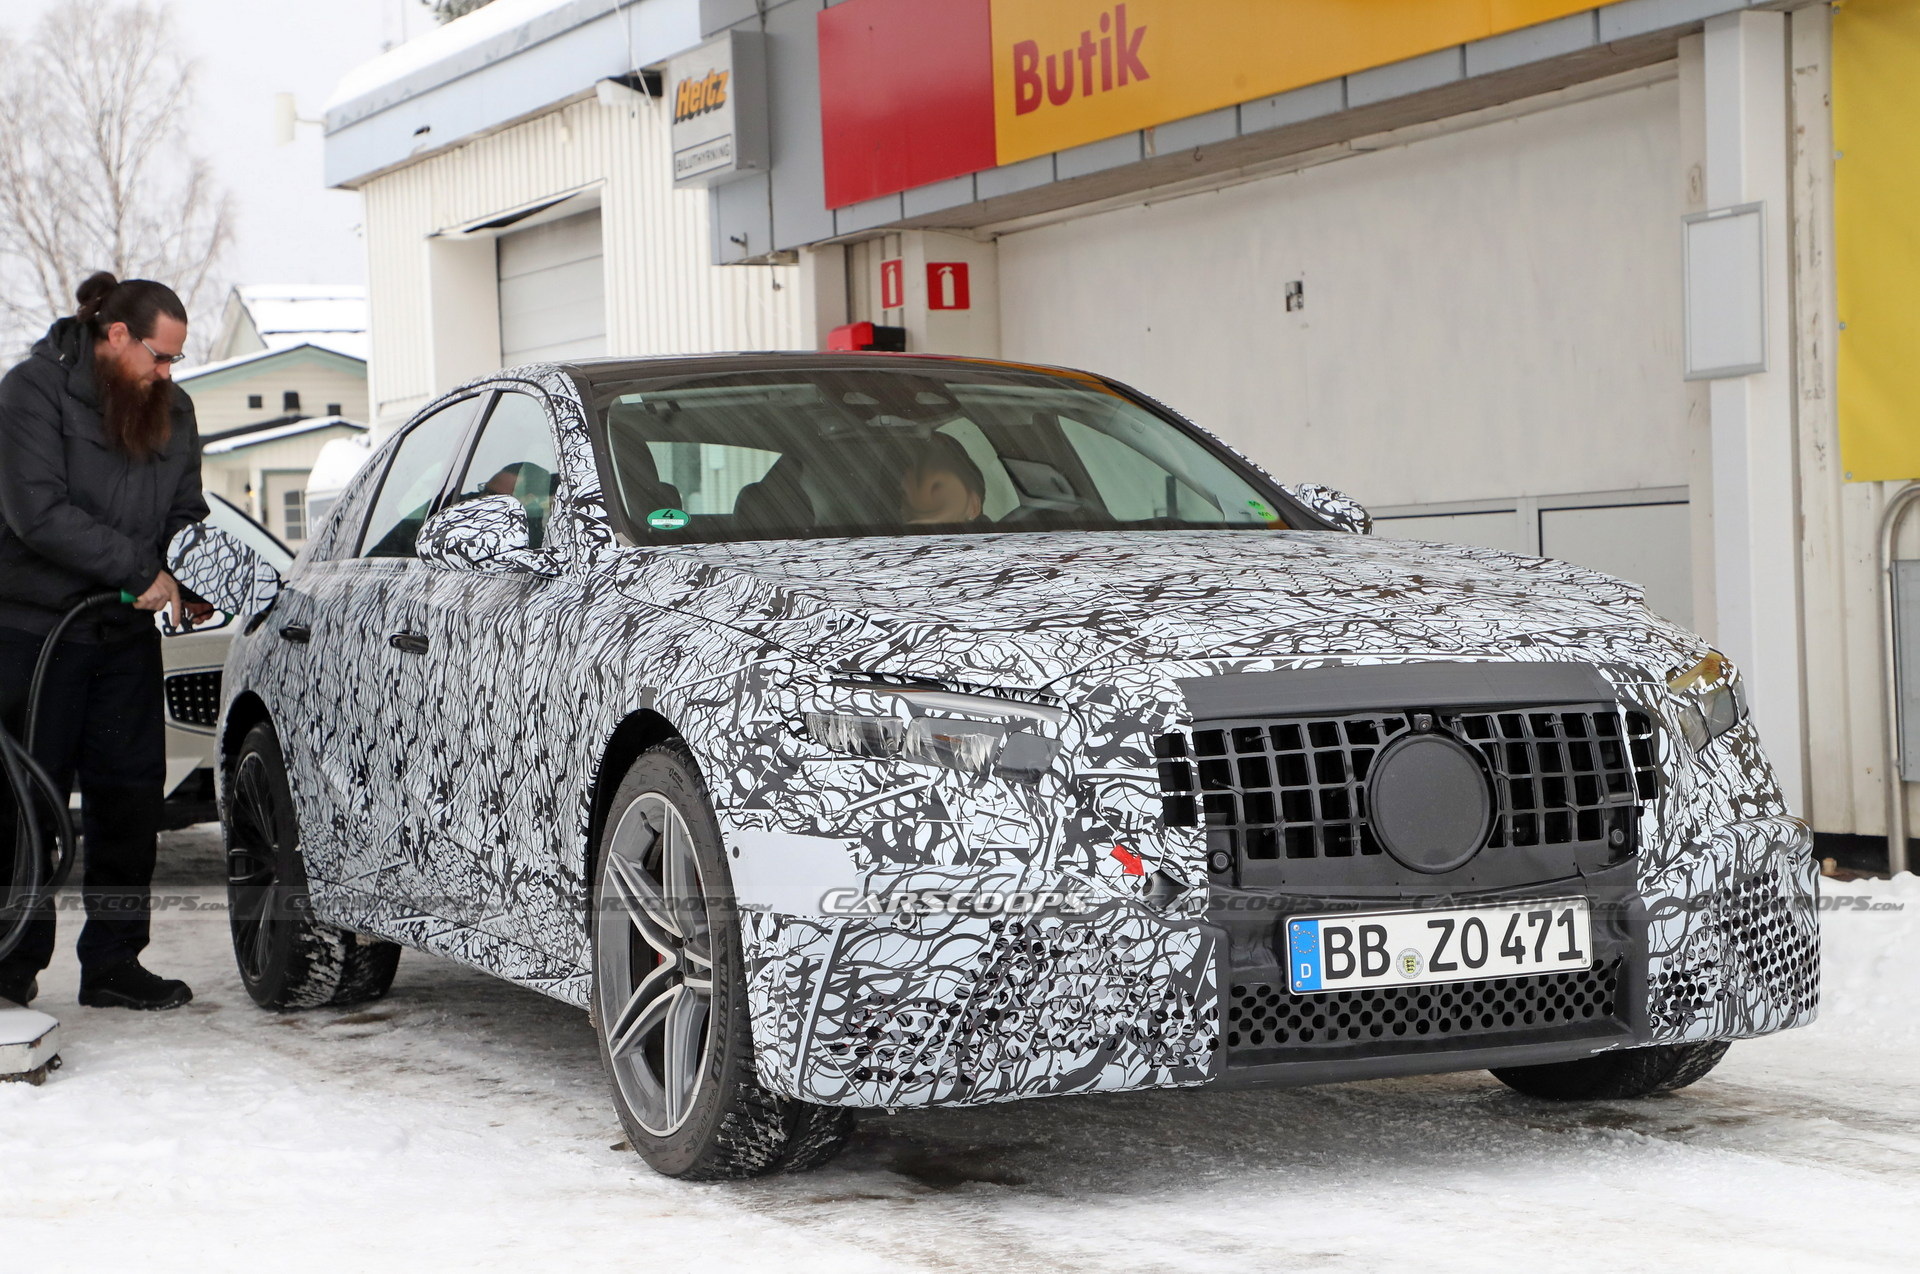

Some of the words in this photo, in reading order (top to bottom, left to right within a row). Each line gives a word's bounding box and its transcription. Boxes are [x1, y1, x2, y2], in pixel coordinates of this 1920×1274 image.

[1013, 3, 1150, 116] Butik
[674, 68, 729, 124] Hertz
[662, 509, 675, 519] 4
[1301, 963, 1312, 979] D
[1323, 924, 1391, 980] BB
[1427, 917, 1489, 973] ZO
[1500, 908, 1583, 965] 471
[712, 962, 729, 1081] MICHELIN
